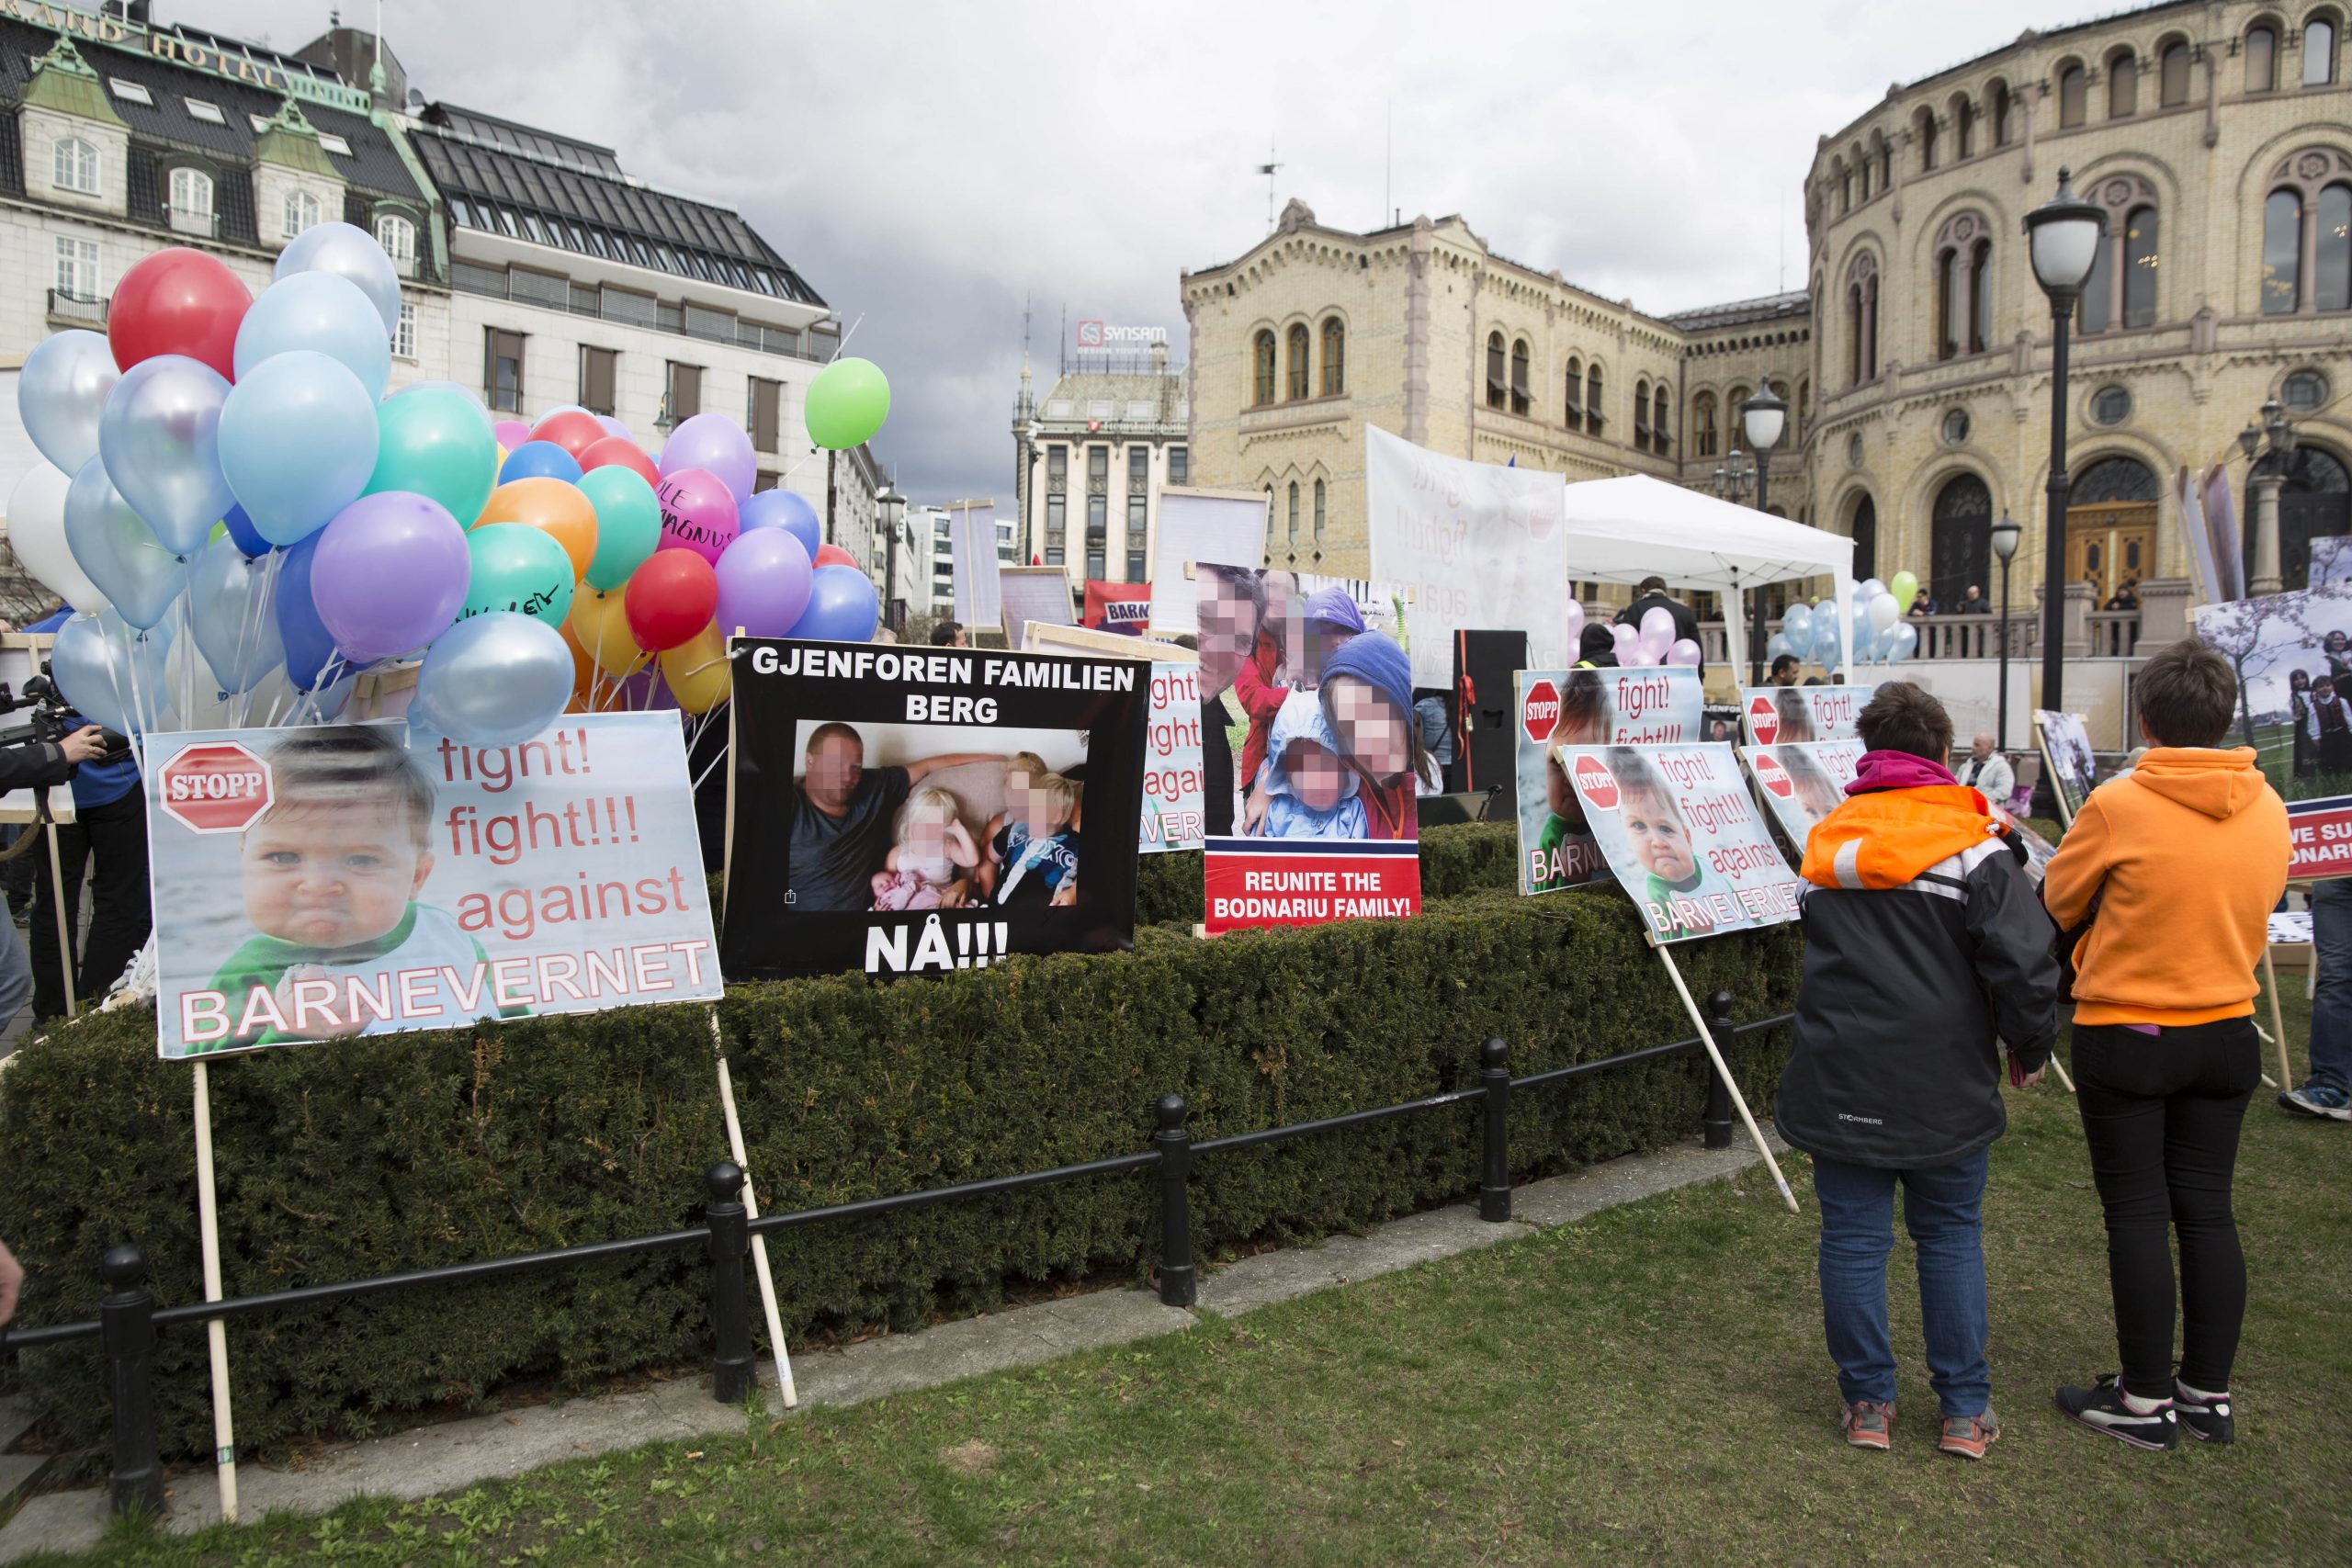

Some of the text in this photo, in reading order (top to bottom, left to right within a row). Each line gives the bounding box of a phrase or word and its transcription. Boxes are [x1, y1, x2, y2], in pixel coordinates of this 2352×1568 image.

[152, 32, 279, 89] HOTEL
[1104, 326, 1167, 341] SYNSAM
[752, 647, 1135, 692] GJENFOREN FAMILIEN
[906, 694, 998, 724] BERG
[1527, 701, 1557, 721] STOPP
[1618, 676, 1669, 719] fight!
[1814, 694, 1852, 729] fight!
[1752, 712, 1777, 728] STOPP
[171, 773, 263, 800] STOPP
[1578, 772, 1614, 790] STOPP
[1657, 751, 1715, 790] fight!
[1758, 767, 1787, 783] STOPP
[445, 795, 639, 865] fight!!!
[1680, 793, 1751, 834] fight!!!
[1708, 839, 1782, 880] against
[1245, 872, 1381, 892] REUNITE THE
[457, 866, 689, 940] against
[1214, 897, 1411, 919] BODNARIU FAMILY!
[865, 913, 1008, 973] NÅ!!!
[178, 940, 709, 1043] BARNEVERNET
[1838, 1113, 1883, 1124] STORMBERG
